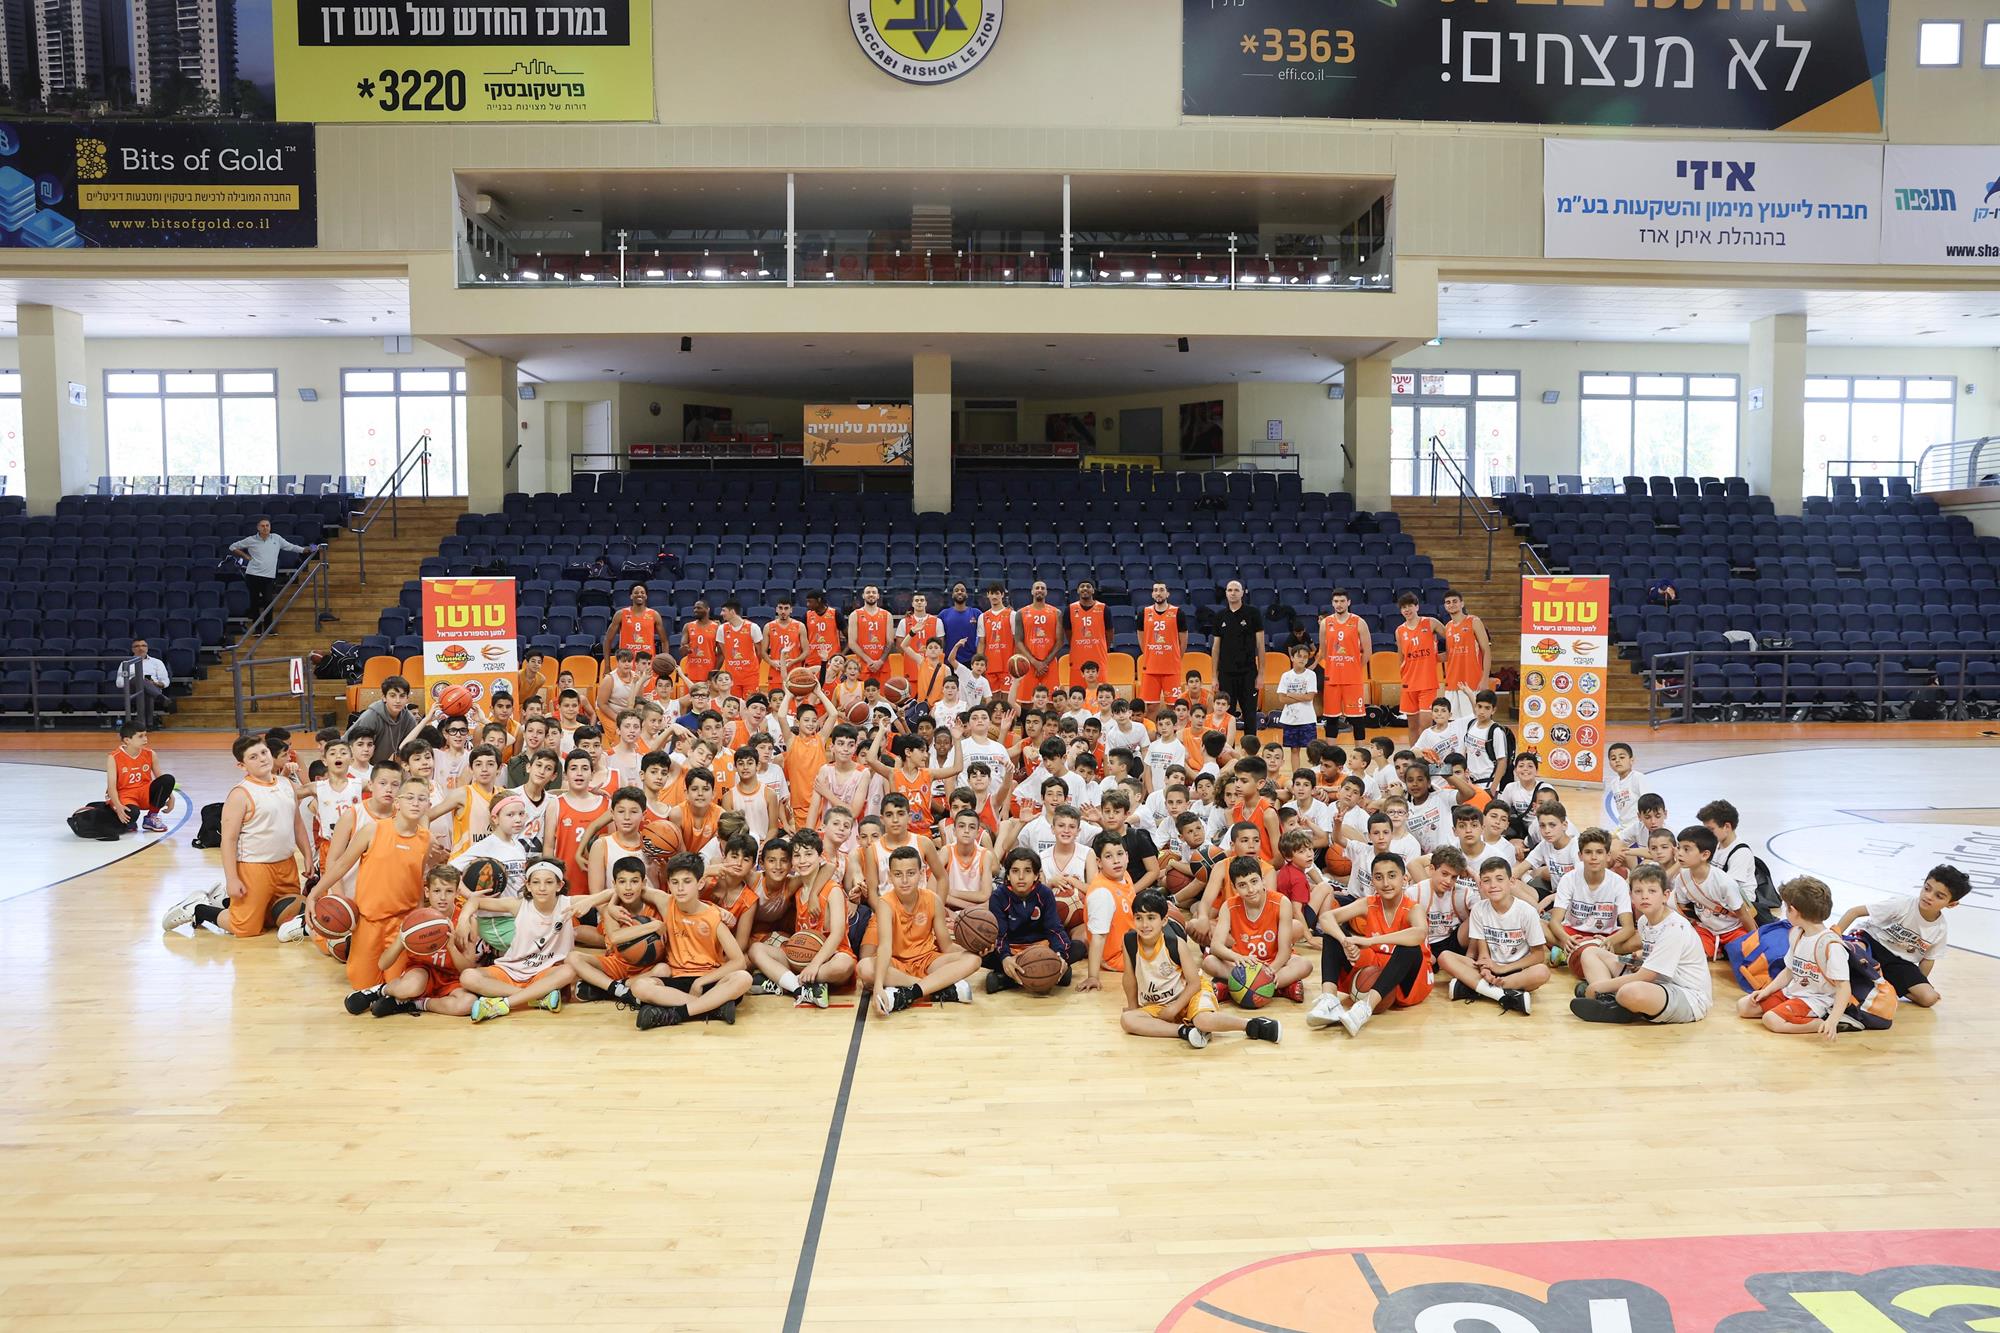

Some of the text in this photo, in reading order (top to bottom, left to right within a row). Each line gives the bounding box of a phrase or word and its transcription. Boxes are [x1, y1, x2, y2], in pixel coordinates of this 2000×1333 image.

[321, 2, 608, 43] במרכז החדש של גוש דן
[857, 12, 898, 69] MACCABI
[903, 61, 958, 77] RISHON
[961, 47, 977, 64] LE
[976, 12, 996, 47] ZION
[1441, 18, 1812, 92] לא מנצחים!
[1278, 68, 1325, 82] effi.co.il
[484, 82, 585, 100] פרשקובסקי
[549, 101, 562, 110] של
[120, 147, 175, 171] Bits
[183, 148, 211, 171] of
[218, 148, 284, 171] Gold
[1676, 160, 1756, 192] איזי
[126, 192, 163, 202] ומטבעות
[165, 192, 193, 204] ביטקוין
[195, 191, 226, 202] לרכישת
[227, 191, 262, 202] המובילה
[263, 193, 292, 202] החברה
[1894, 188, 1957, 211] תנופה
[1614, 198, 1700, 222] והשקעות
[1705, 201, 1753, 222] מימון
[1758, 200, 1813, 224] לייעוץ
[1818, 204, 1868, 220] חברה
[109, 218, 270, 231] www.bitsofgold.co.il
[1640, 226, 1786, 248] בהנהלת איתן ארז
[1946, 244, 2000, 257] www.sha
[1397, 385, 1405, 393] 6
[808, 421, 908, 434] עמדת טלוויזיה
[434, 604, 506, 628] טוטו
[1532, 601, 1598, 623] טוטו
[868, 621, 878, 631] 21
[992, 621, 1002, 630] 24
[1034, 615, 1047, 625] 20
[1082, 616, 1092, 626] 15
[1154, 621, 1166, 631] 25
[490, 629, 506, 637] למען
[635, 622, 641, 632] 8
[816, 622, 826, 632] 10
[697, 635, 704, 644] 0
[779, 635, 789, 645] 13
[917, 630, 925, 639] 11
[1337, 630, 1344, 641] 9
[733, 638, 740, 648] 2
[293, 660, 301, 690] A
[1357, 697, 1363, 708] 9
[128, 772, 141, 784] 23
[716, 771, 726, 783] 21
[908, 792, 922, 805] 24
[525, 821, 540, 836] 24
[1122, 900, 1129, 913] 6
